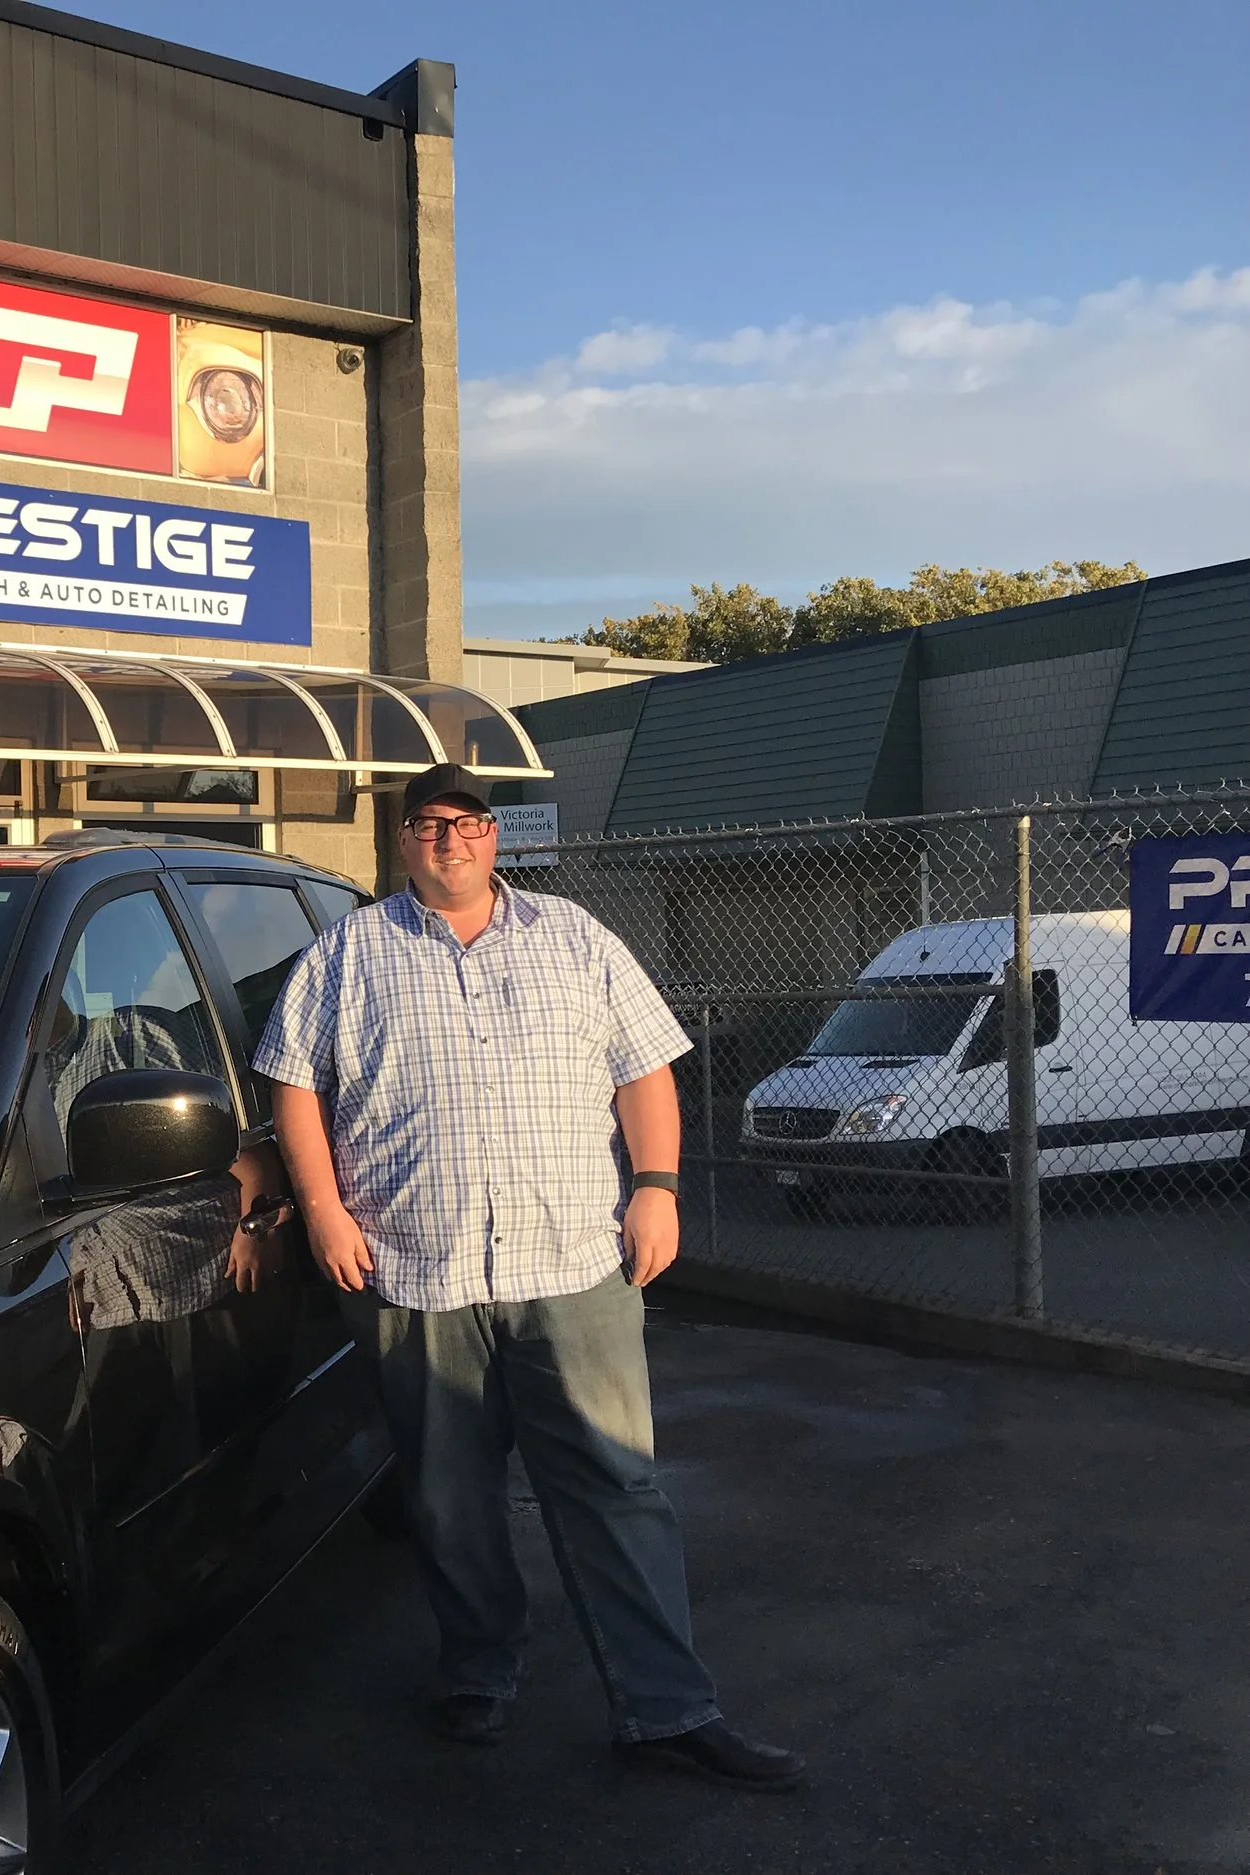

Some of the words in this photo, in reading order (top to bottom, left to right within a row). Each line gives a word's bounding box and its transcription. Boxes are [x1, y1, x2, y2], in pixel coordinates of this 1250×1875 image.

[18, 580, 30, 598] &
[40, 583, 102, 605] AUTO
[112, 590, 229, 616] DETAILING
[500, 808, 545, 820] Victoria
[503, 820, 554, 832] Millwork
